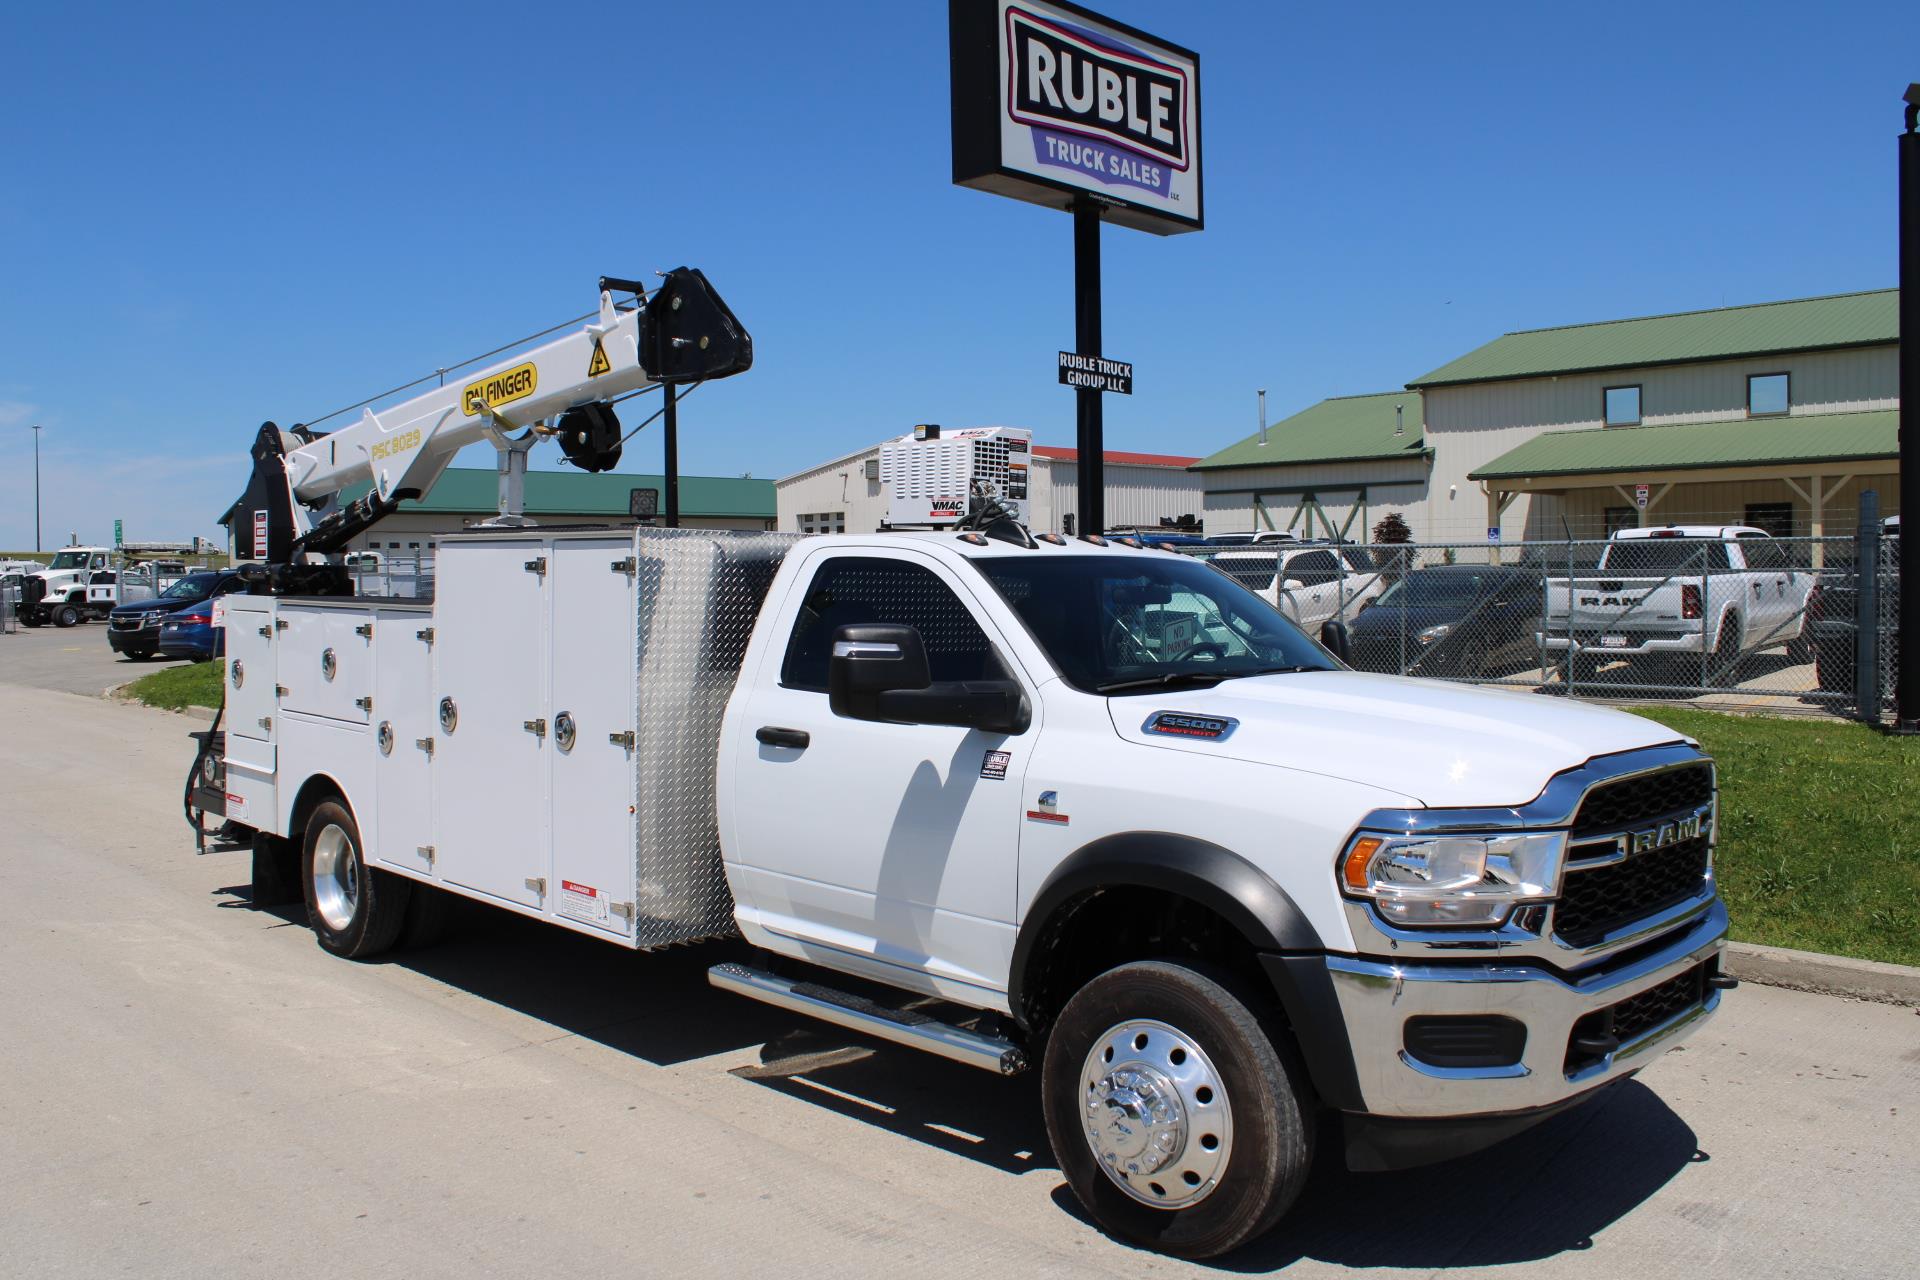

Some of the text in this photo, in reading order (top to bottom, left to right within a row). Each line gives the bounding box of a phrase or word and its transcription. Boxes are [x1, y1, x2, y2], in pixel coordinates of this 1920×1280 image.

[1027, 36, 1174, 146] RUBLE
[1045, 136, 1161, 188] TRUCK SALES
[1170, 191, 1180, 201] LLC
[1060, 352, 1131, 378] RUBLE TRUCK
[1067, 370, 1125, 392] GROUP LLC
[932, 501, 964, 510] VMAC
[1580, 597, 1643, 606] RAM
[1162, 716, 1221, 730] 5500
[1633, 814, 1701, 855] RAM
